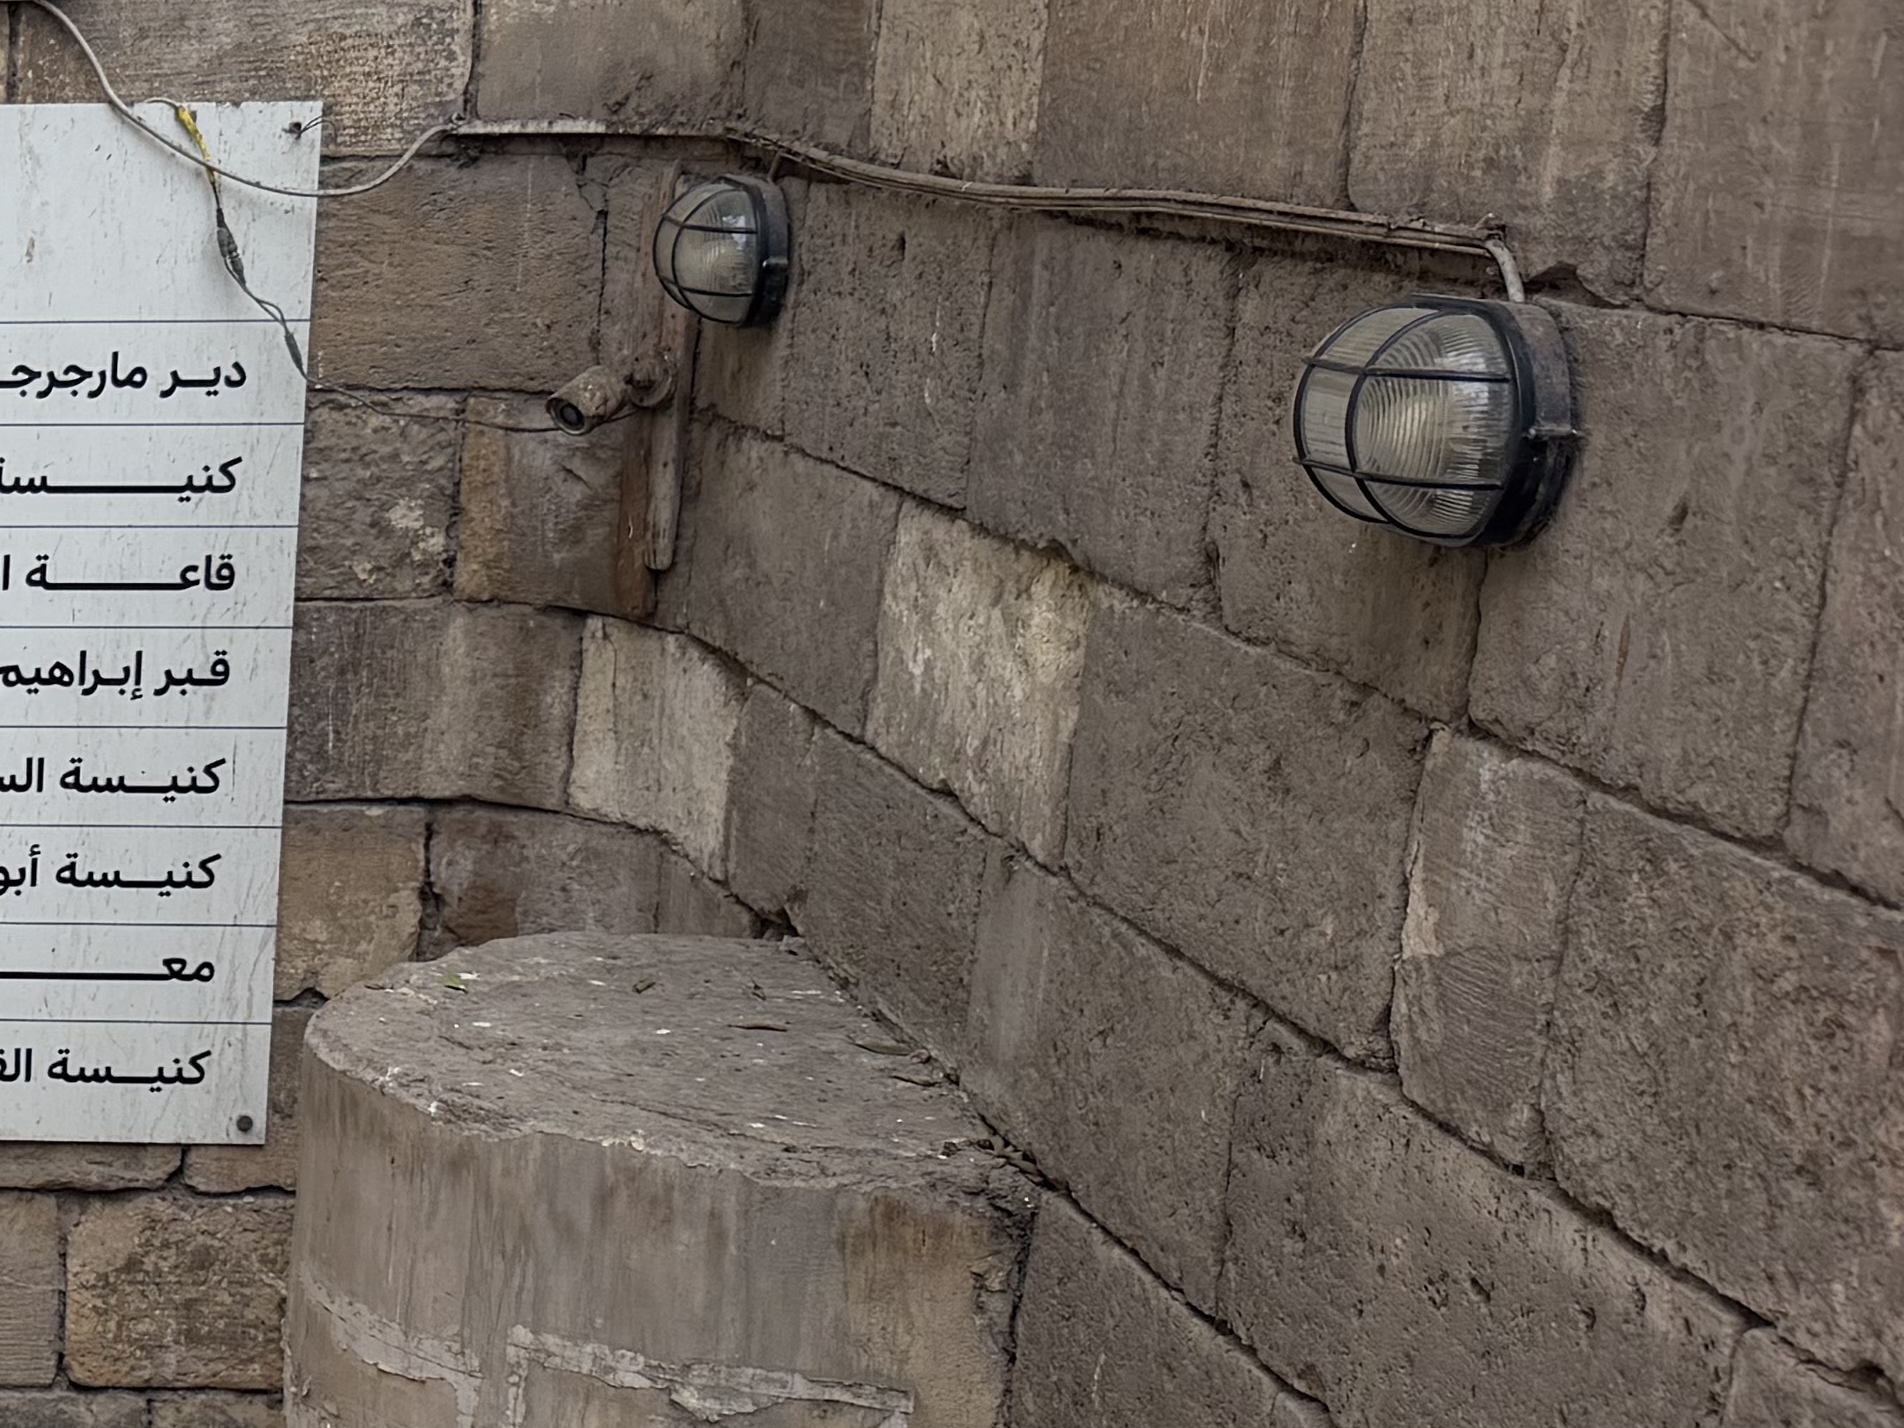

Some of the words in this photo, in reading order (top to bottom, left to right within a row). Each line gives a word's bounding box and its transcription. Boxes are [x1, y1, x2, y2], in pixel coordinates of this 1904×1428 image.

[160, 360, 246, 398] دير
[26, 554, 235, 591] قاعة
[153, 650, 230, 696] قبر
[59, 757, 226, 802] كنيسة
[55, 852, 221, 898] كنيسة
[47, 1049, 212, 1092] كنيسة
